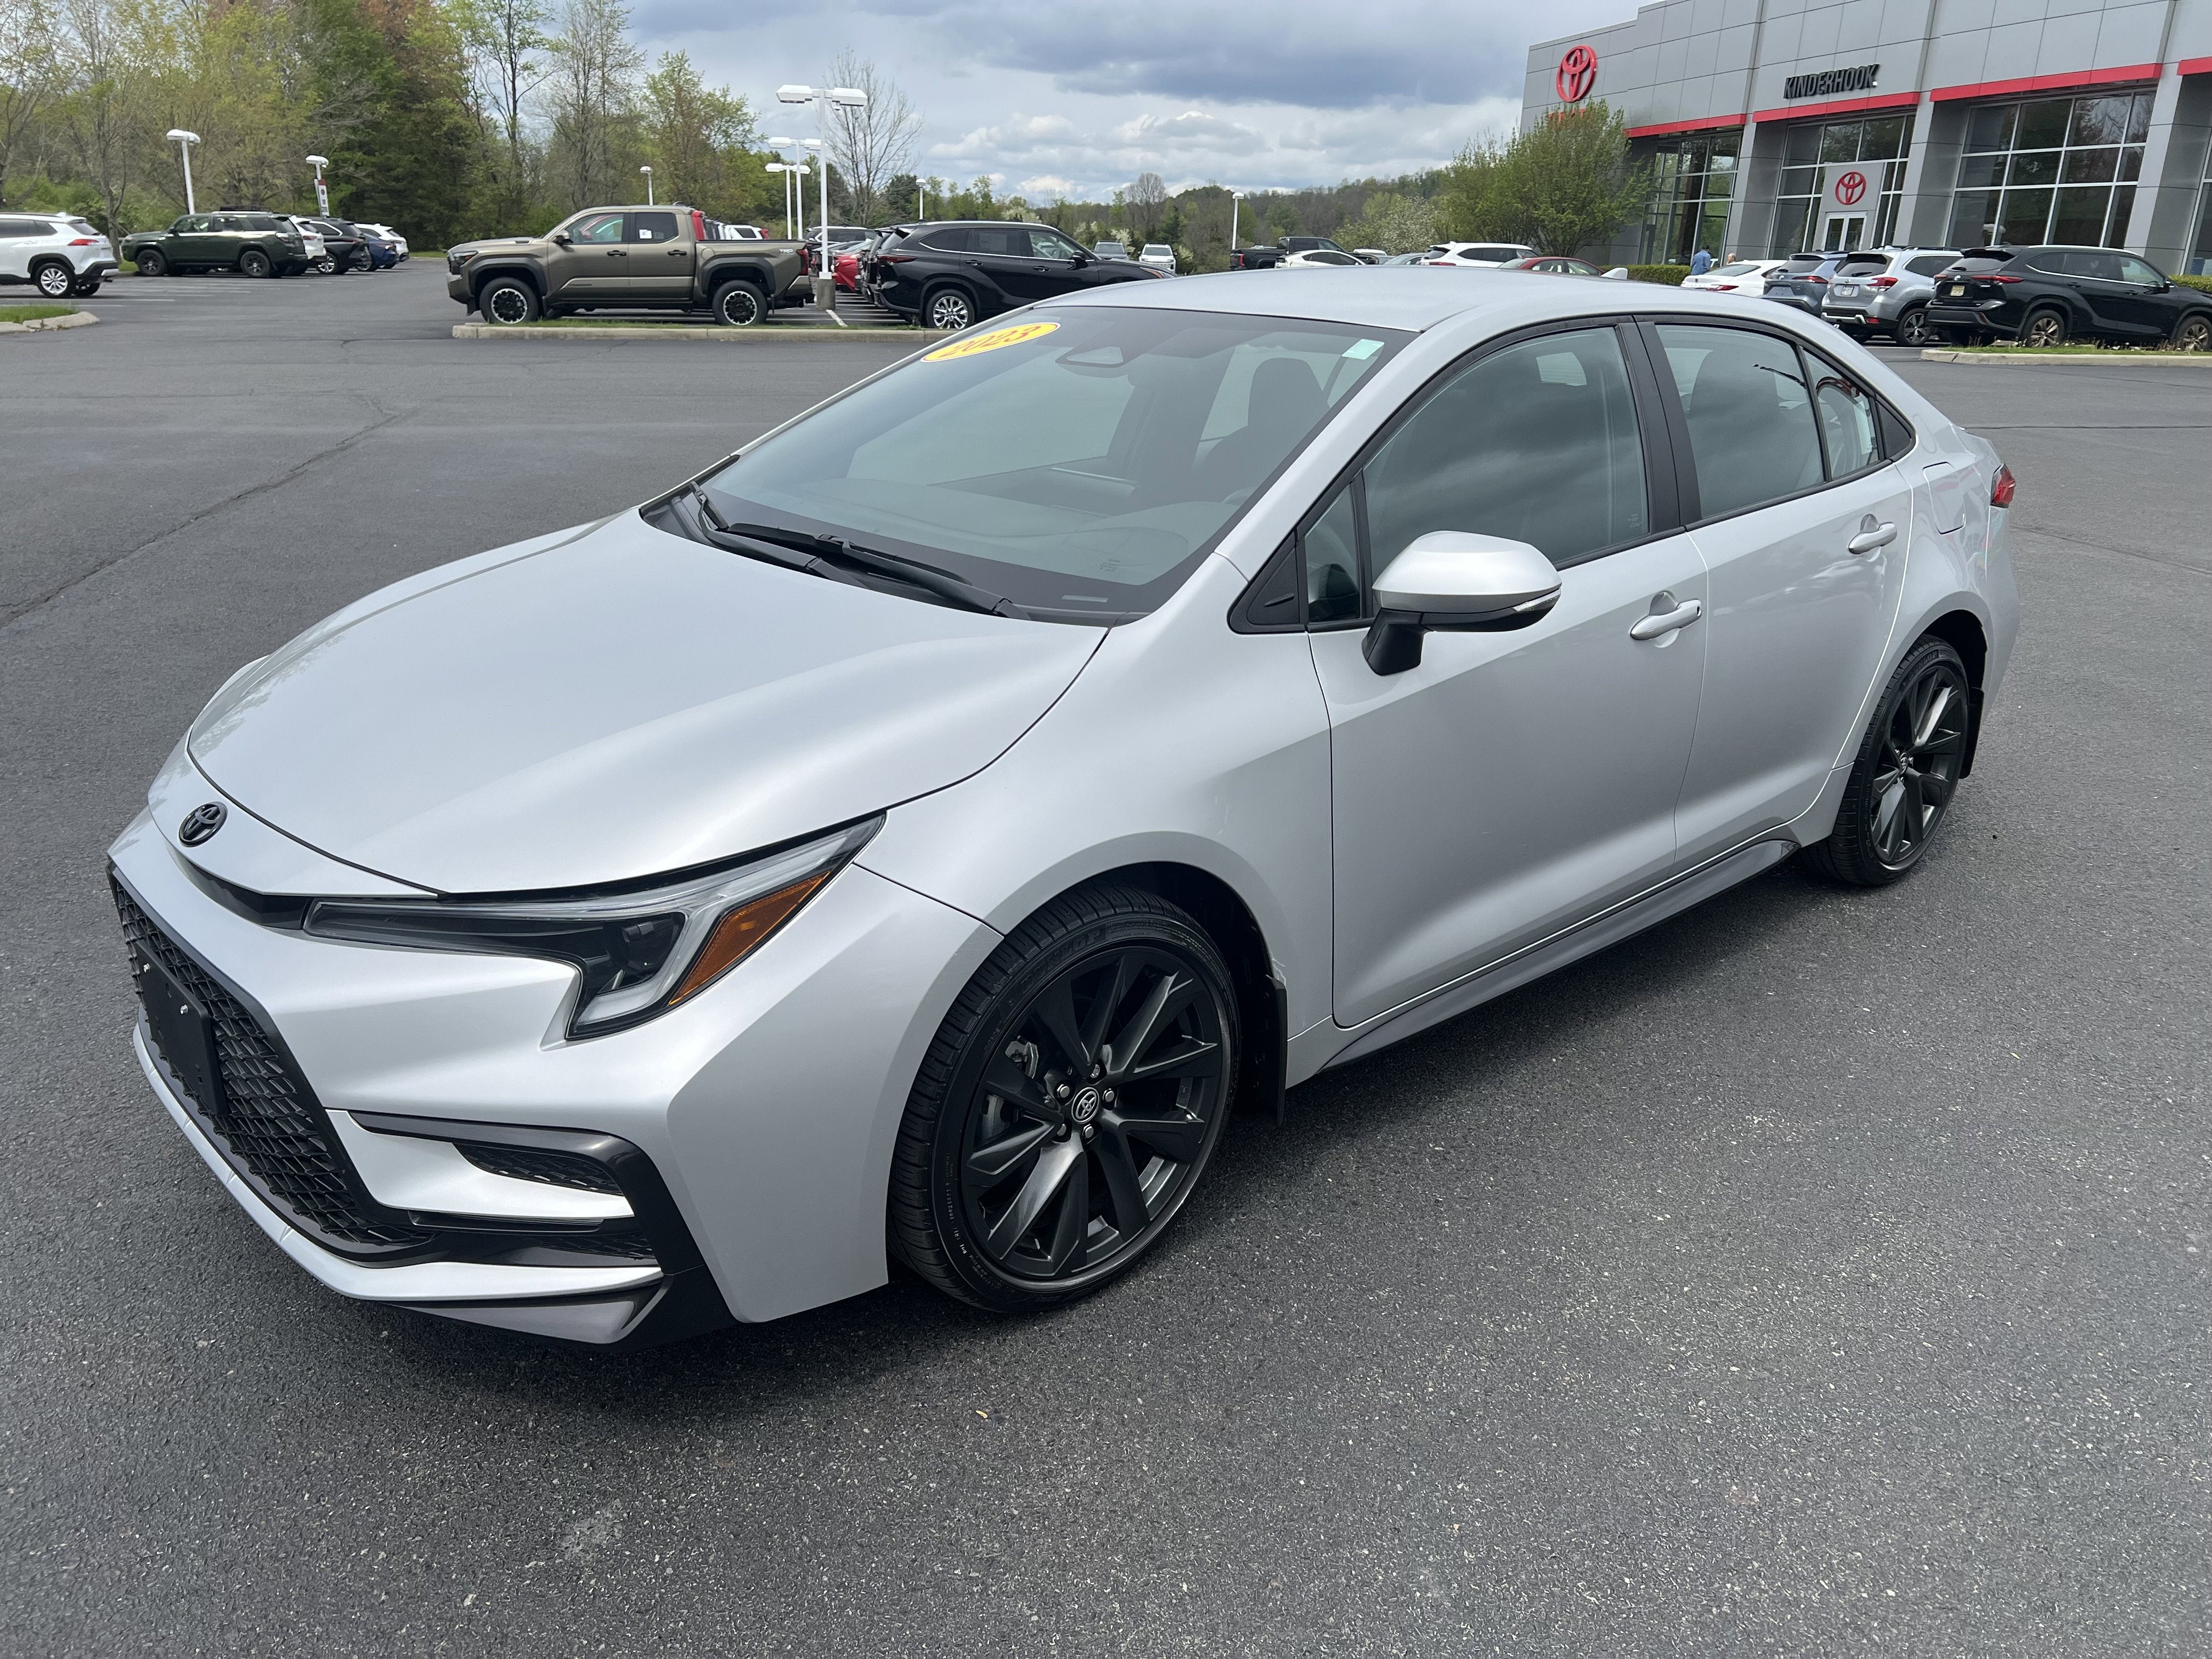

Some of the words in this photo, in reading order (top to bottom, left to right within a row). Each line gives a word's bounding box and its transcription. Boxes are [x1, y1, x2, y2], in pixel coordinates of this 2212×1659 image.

[1784, 64, 1881, 99] KINDERHOOK
[939, 326, 1041, 358] 2023
[1021, 929, 1100, 994] DUNLOP
